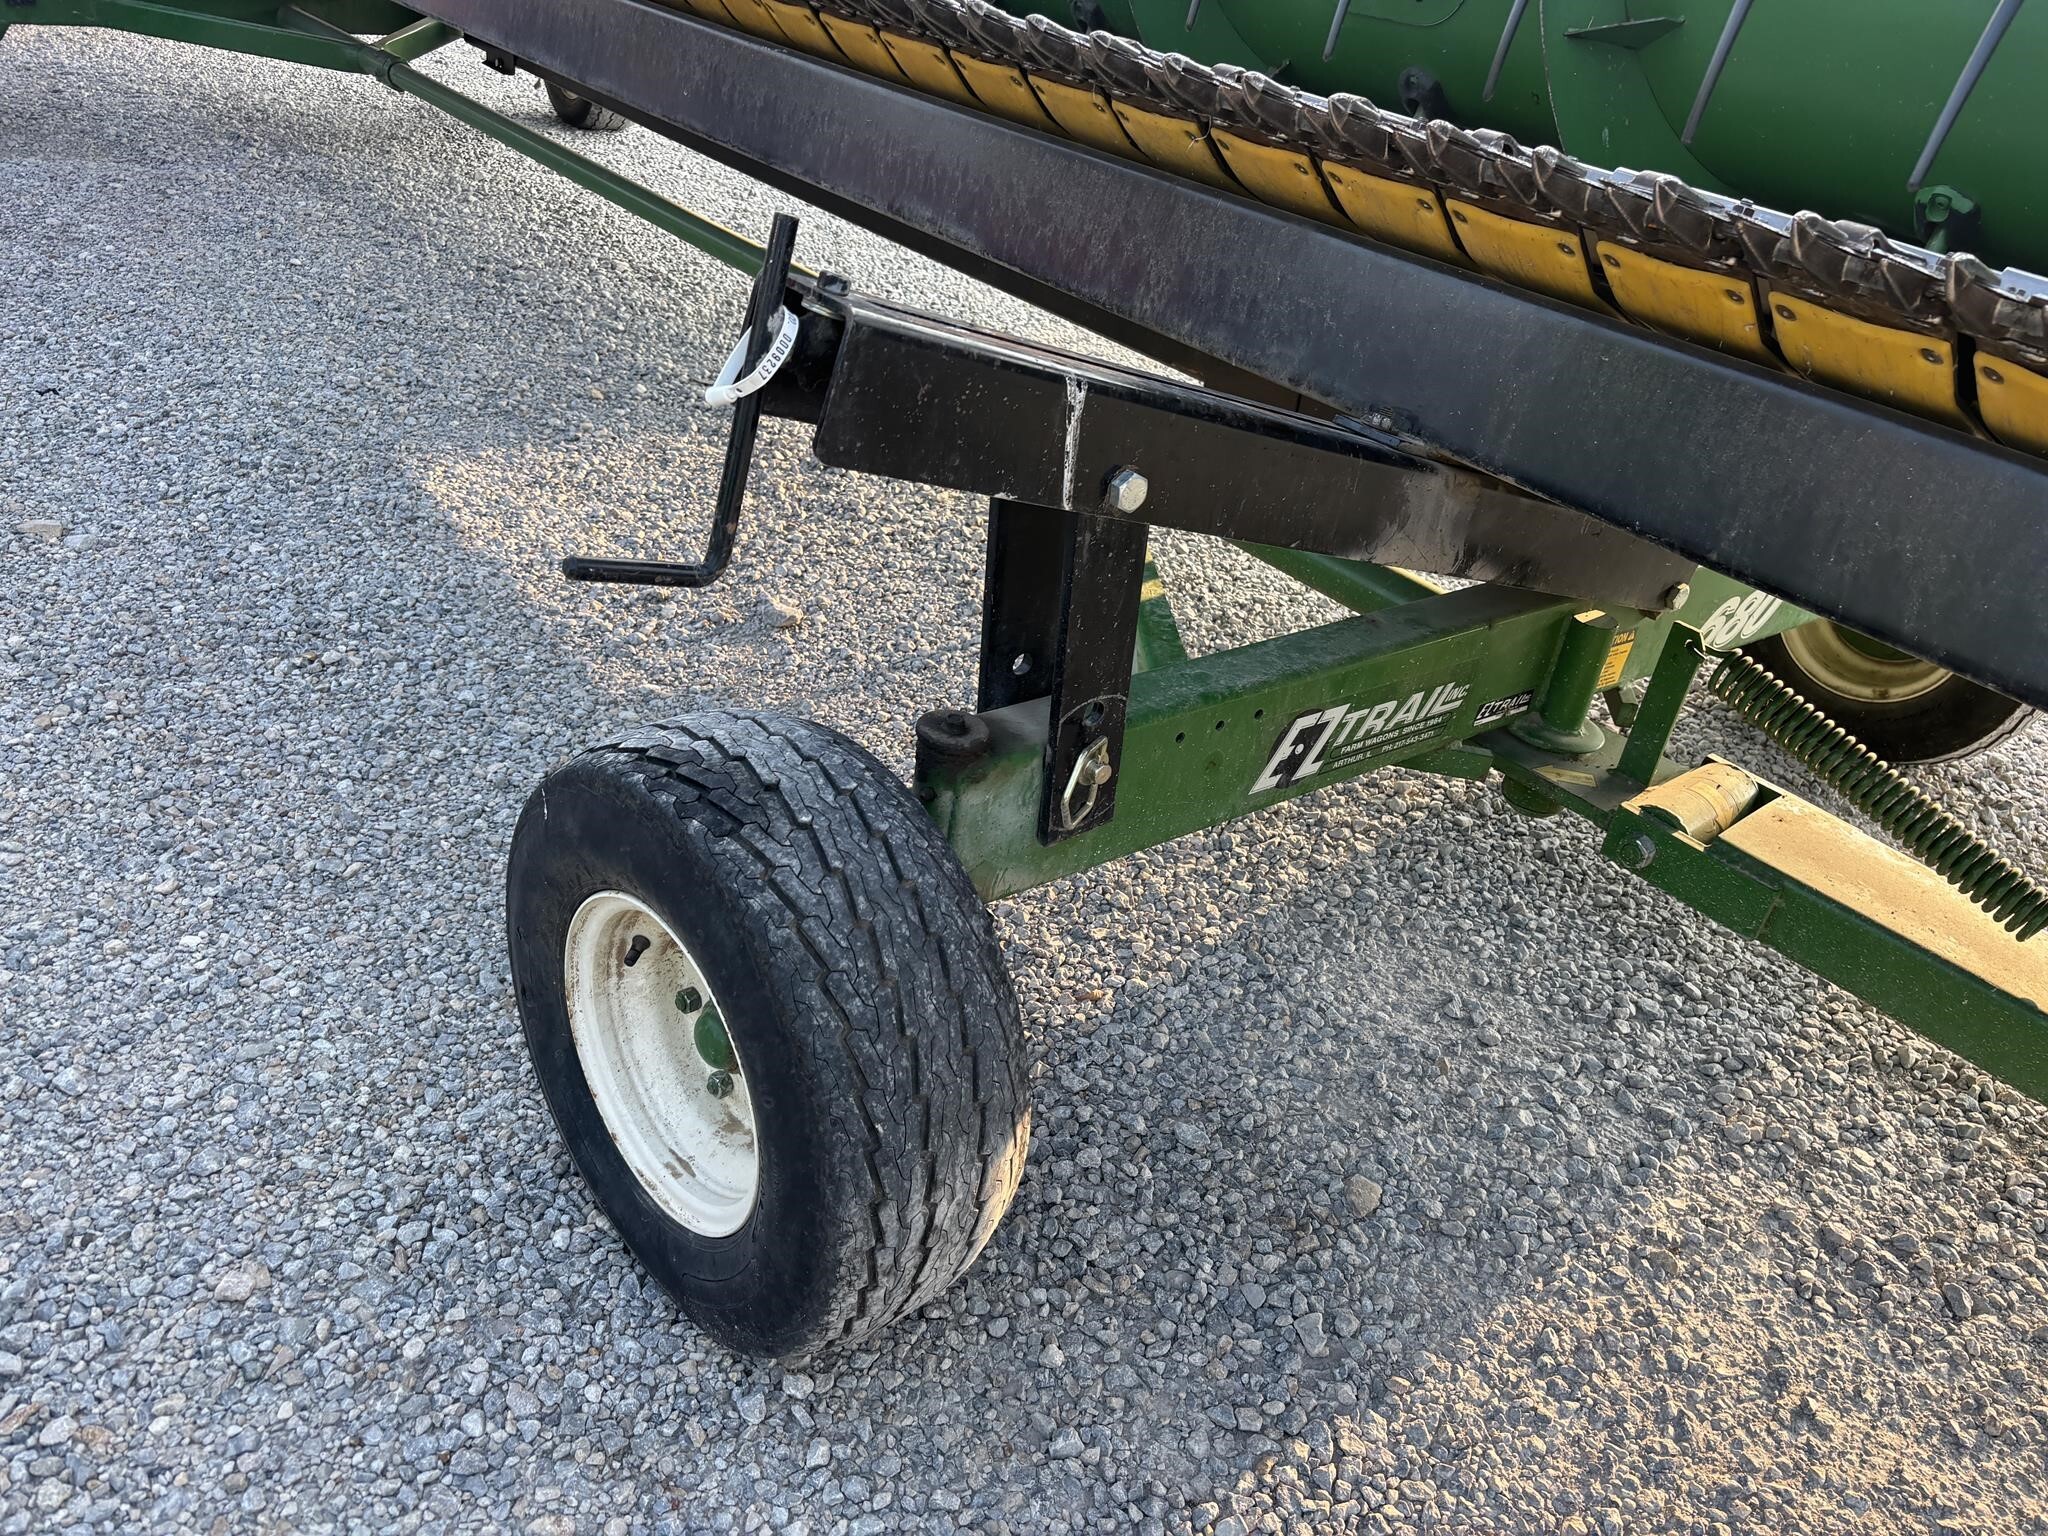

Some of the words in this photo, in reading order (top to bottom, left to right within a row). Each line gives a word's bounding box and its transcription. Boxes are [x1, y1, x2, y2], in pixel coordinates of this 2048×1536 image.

[758, 333, 792, 381] 0009237
[1700, 589, 1783, 648] 680
[1340, 741, 1364, 755] FARM
[1365, 729, 1399, 747] WAGONS
[1402, 721, 1426, 735] SINCE
